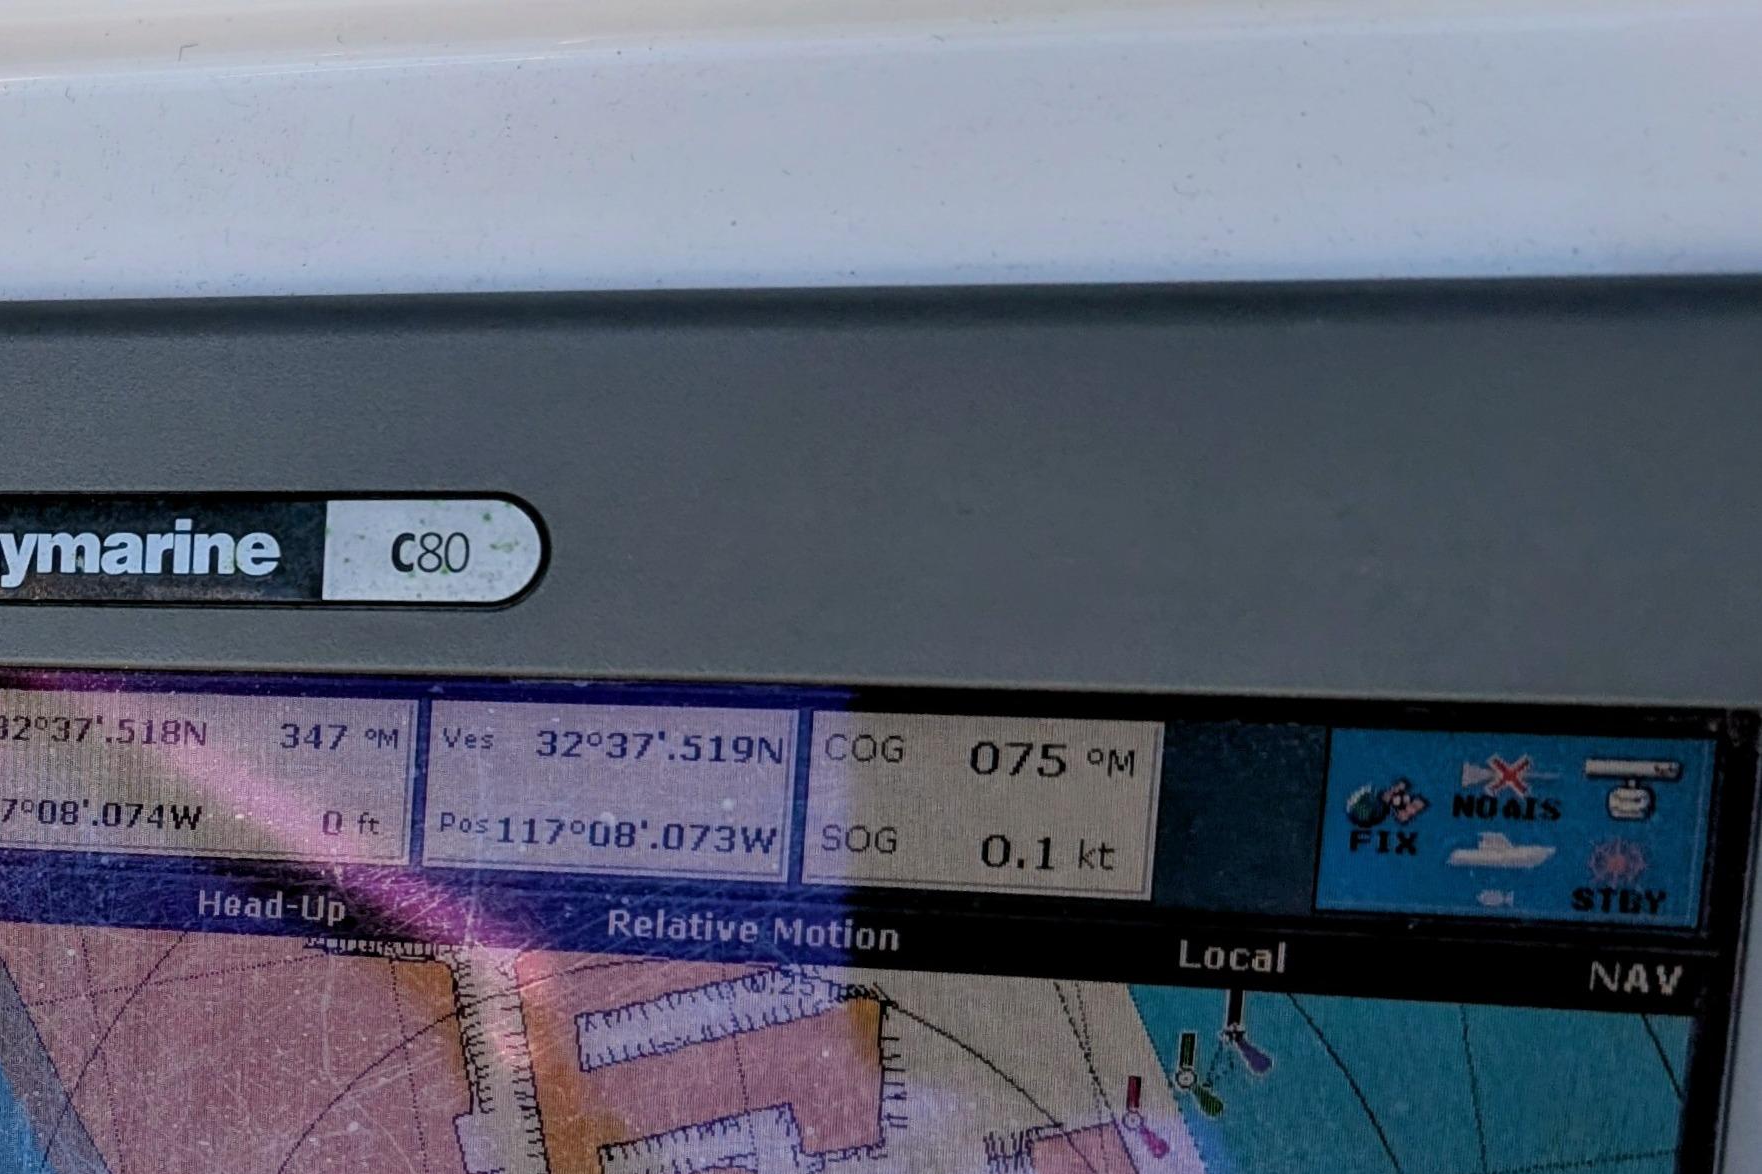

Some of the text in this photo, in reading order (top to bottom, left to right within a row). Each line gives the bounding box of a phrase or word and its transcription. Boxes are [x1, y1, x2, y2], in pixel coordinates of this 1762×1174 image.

[390, 532, 471, 574] C80
[279, 722, 348, 751] 347
[442, 726, 784, 766] Ves 32°37'.519N
[825, 733, 905, 764] COG
[970, 741, 1069, 779] 075
[321, 808, 344, 837] 0
[357, 814, 380, 837] ft
[440, 812, 778, 856] Pos 117°08'.073W
[821, 824, 1116, 872] SOG 0.1 kt
[1349, 831, 1418, 856] FIX
[197, 888, 346, 927] Head-Up
[607, 907, 901, 952] Relative Motion
[1179, 940, 1287, 974] Local
[1588, 960, 1684, 995] NAV
